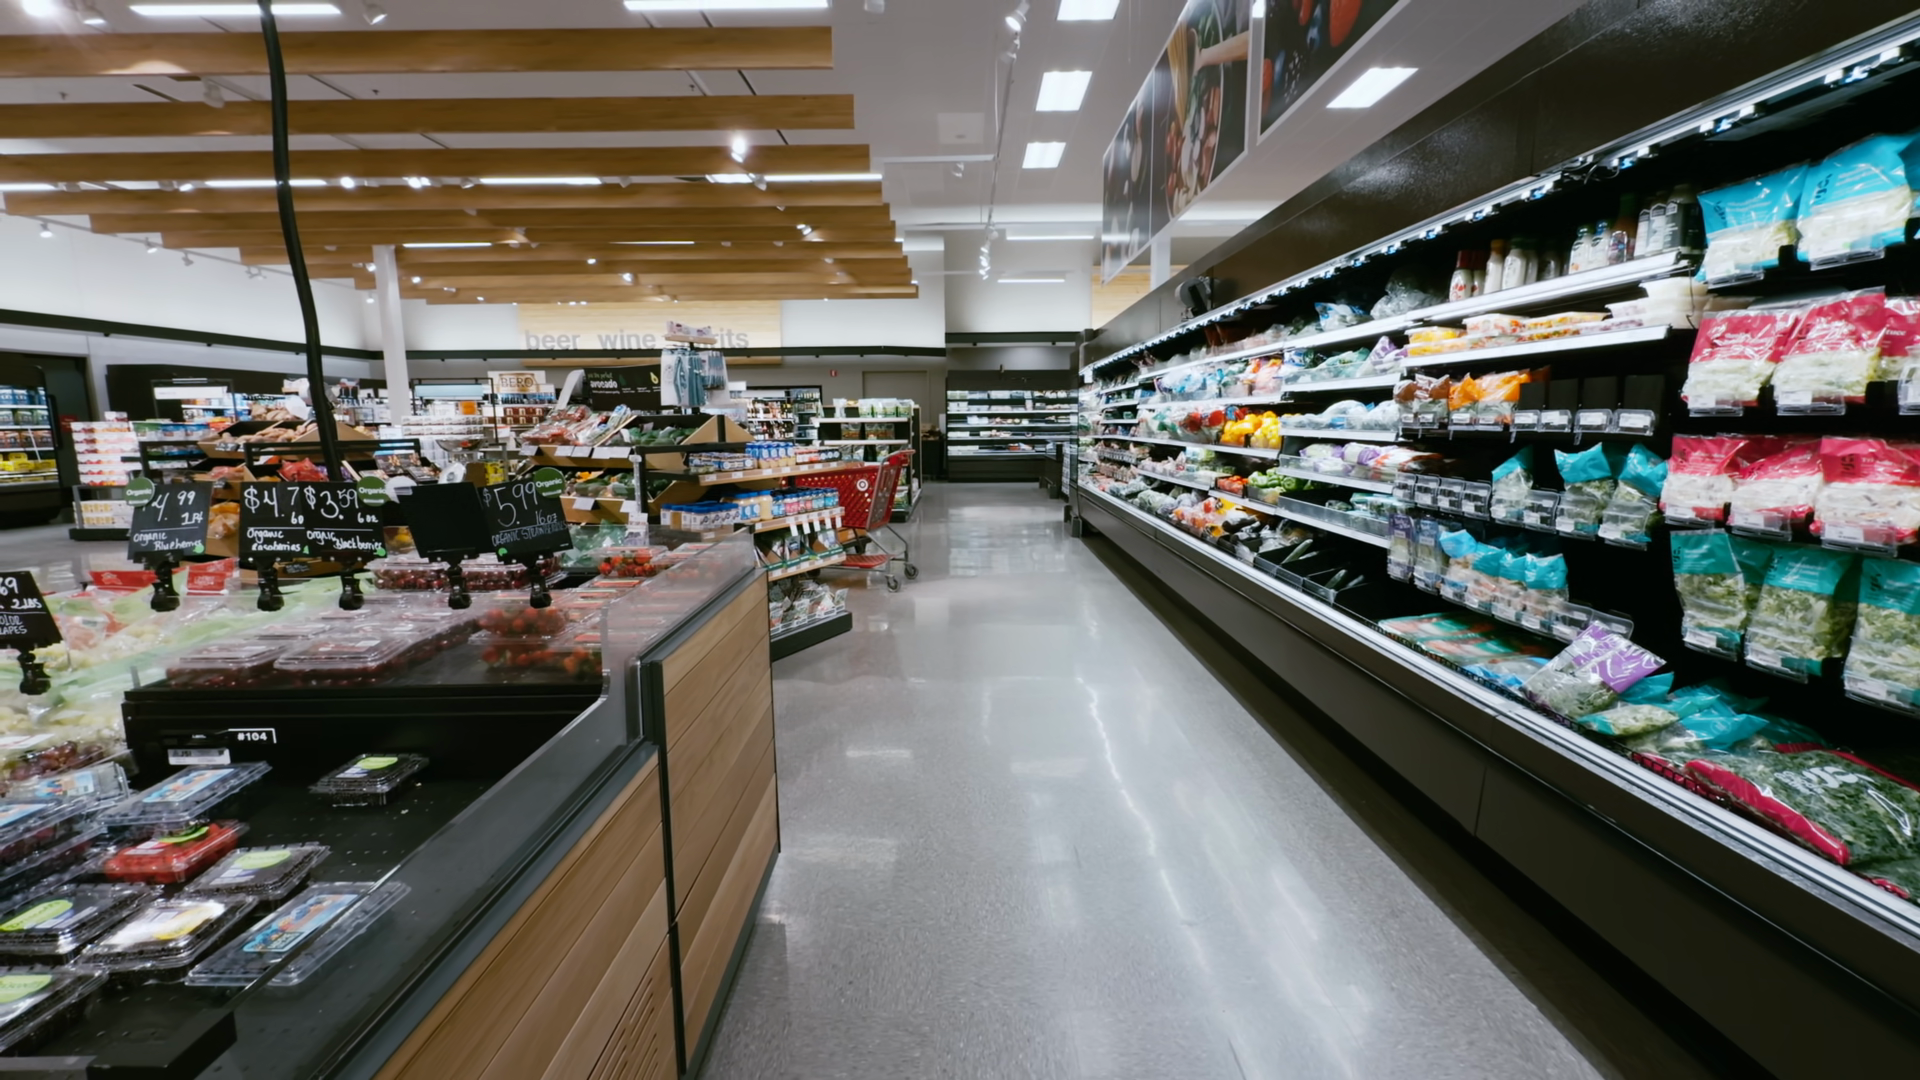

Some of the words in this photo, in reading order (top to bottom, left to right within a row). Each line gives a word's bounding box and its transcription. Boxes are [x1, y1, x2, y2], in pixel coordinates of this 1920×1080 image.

[525, 330, 580, 349] beer
[597, 329, 656, 349] wine
[500, 377, 534, 388] BERO
[590, 379, 618, 388] avocado
[536, 478, 562, 488] Organic
[126, 488, 152, 496] Organic
[358, 486, 388, 495] Organic
[237, 732, 267, 741] #104
